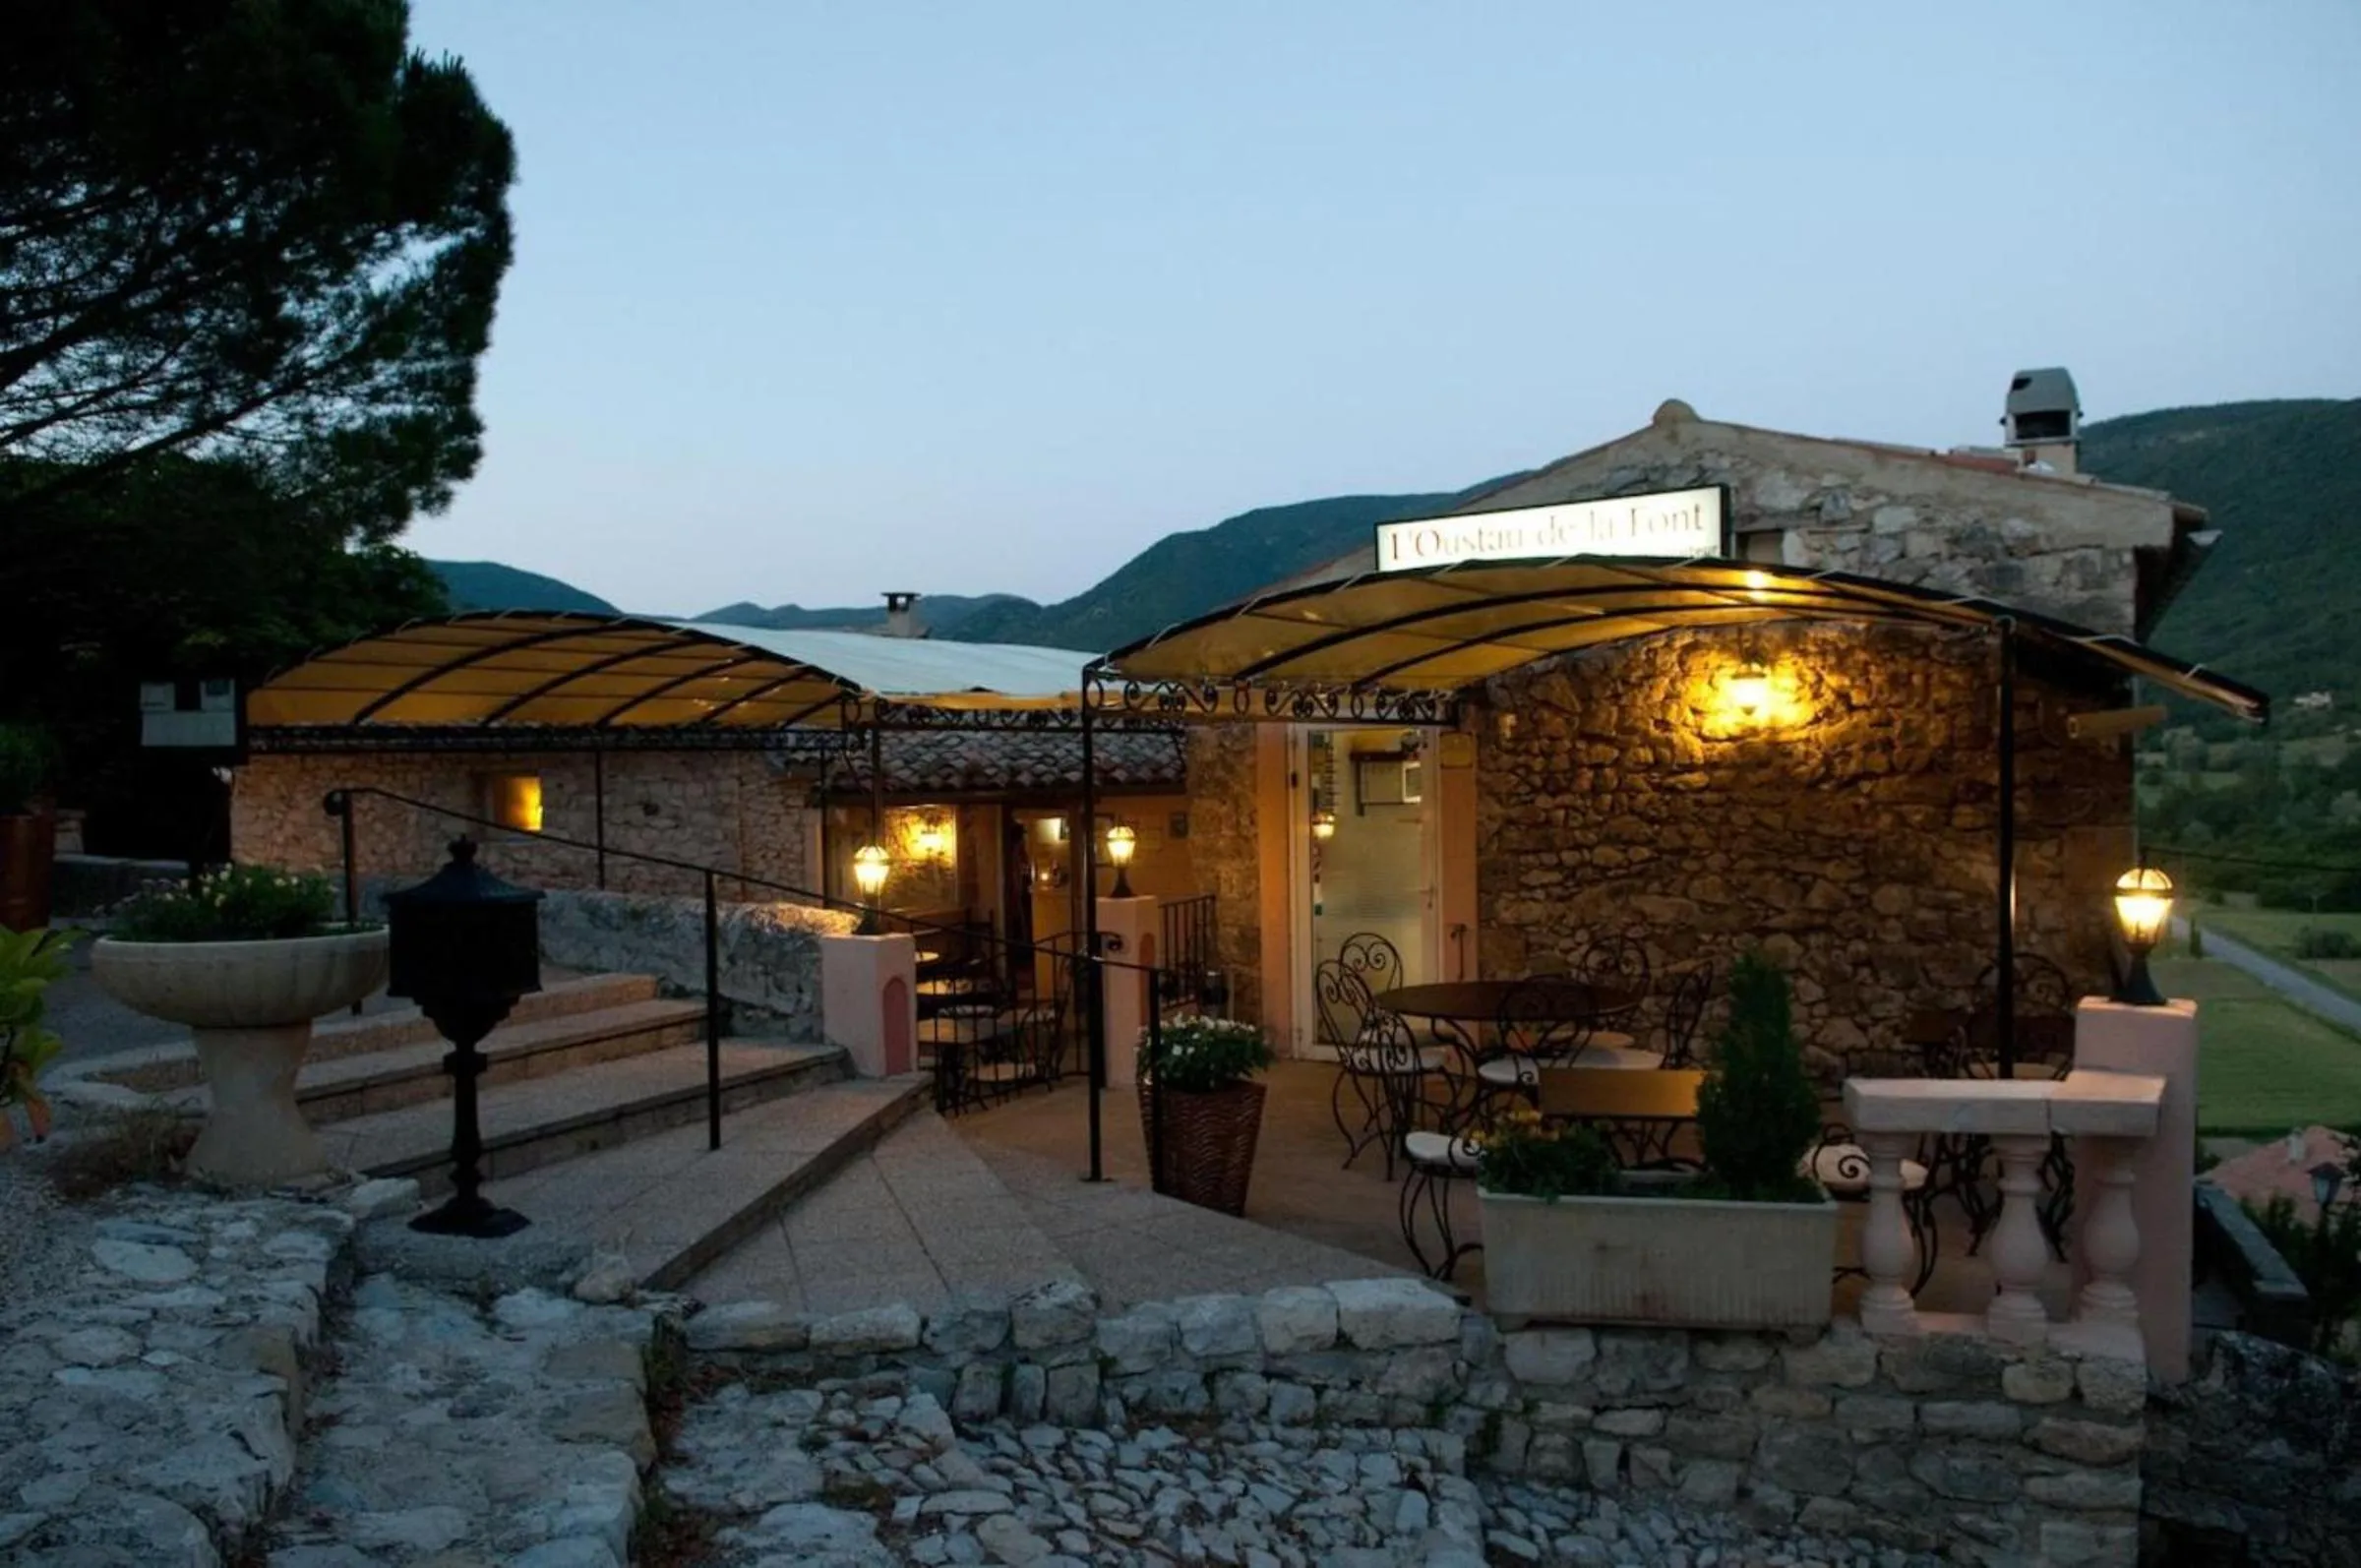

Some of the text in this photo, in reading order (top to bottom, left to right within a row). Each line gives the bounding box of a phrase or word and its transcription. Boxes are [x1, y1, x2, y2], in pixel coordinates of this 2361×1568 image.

[1537, 515, 1574, 546] de
[1590, 510, 1613, 541] la
[1630, 504, 1704, 537] Font
